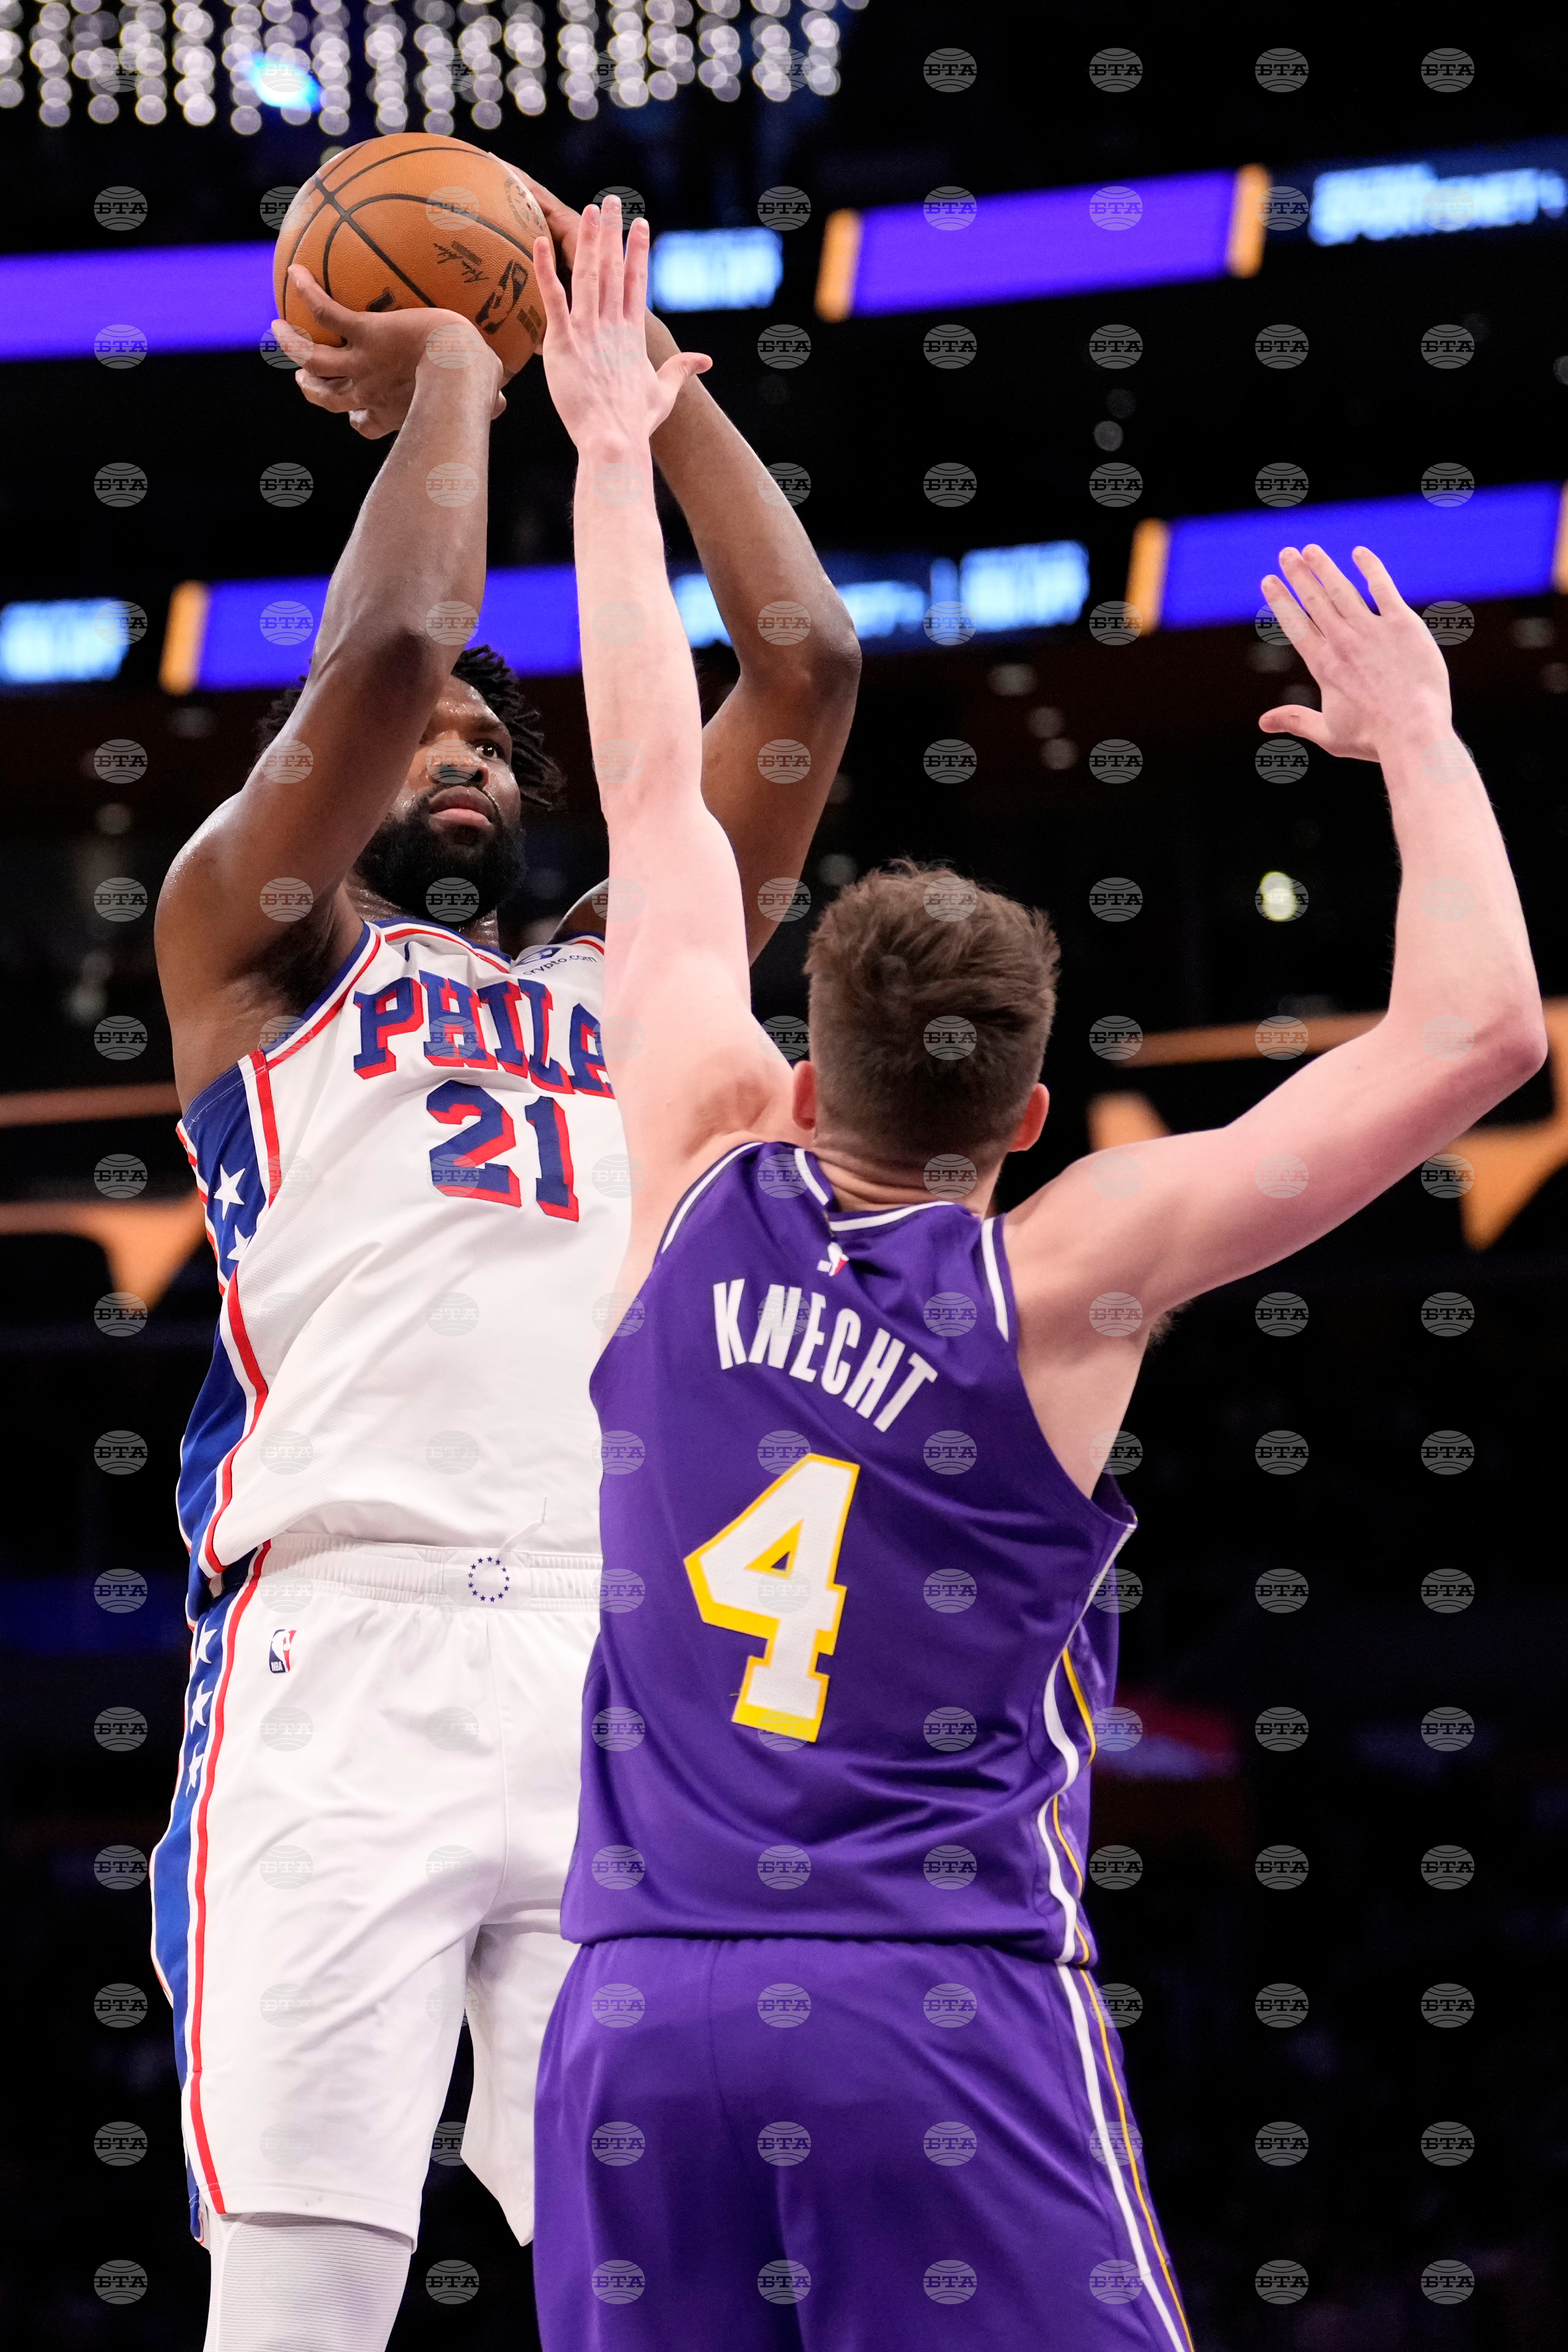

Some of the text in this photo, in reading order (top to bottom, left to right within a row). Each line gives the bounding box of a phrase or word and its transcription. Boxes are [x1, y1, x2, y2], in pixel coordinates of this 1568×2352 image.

[523, 955, 598, 976] crypto.com
[426, 1079, 579, 1222] 21
[713, 1278, 939, 1432] KNECHT
[271, 1661, 283, 1671] NBA
[683, 1452, 860, 1743] 4
